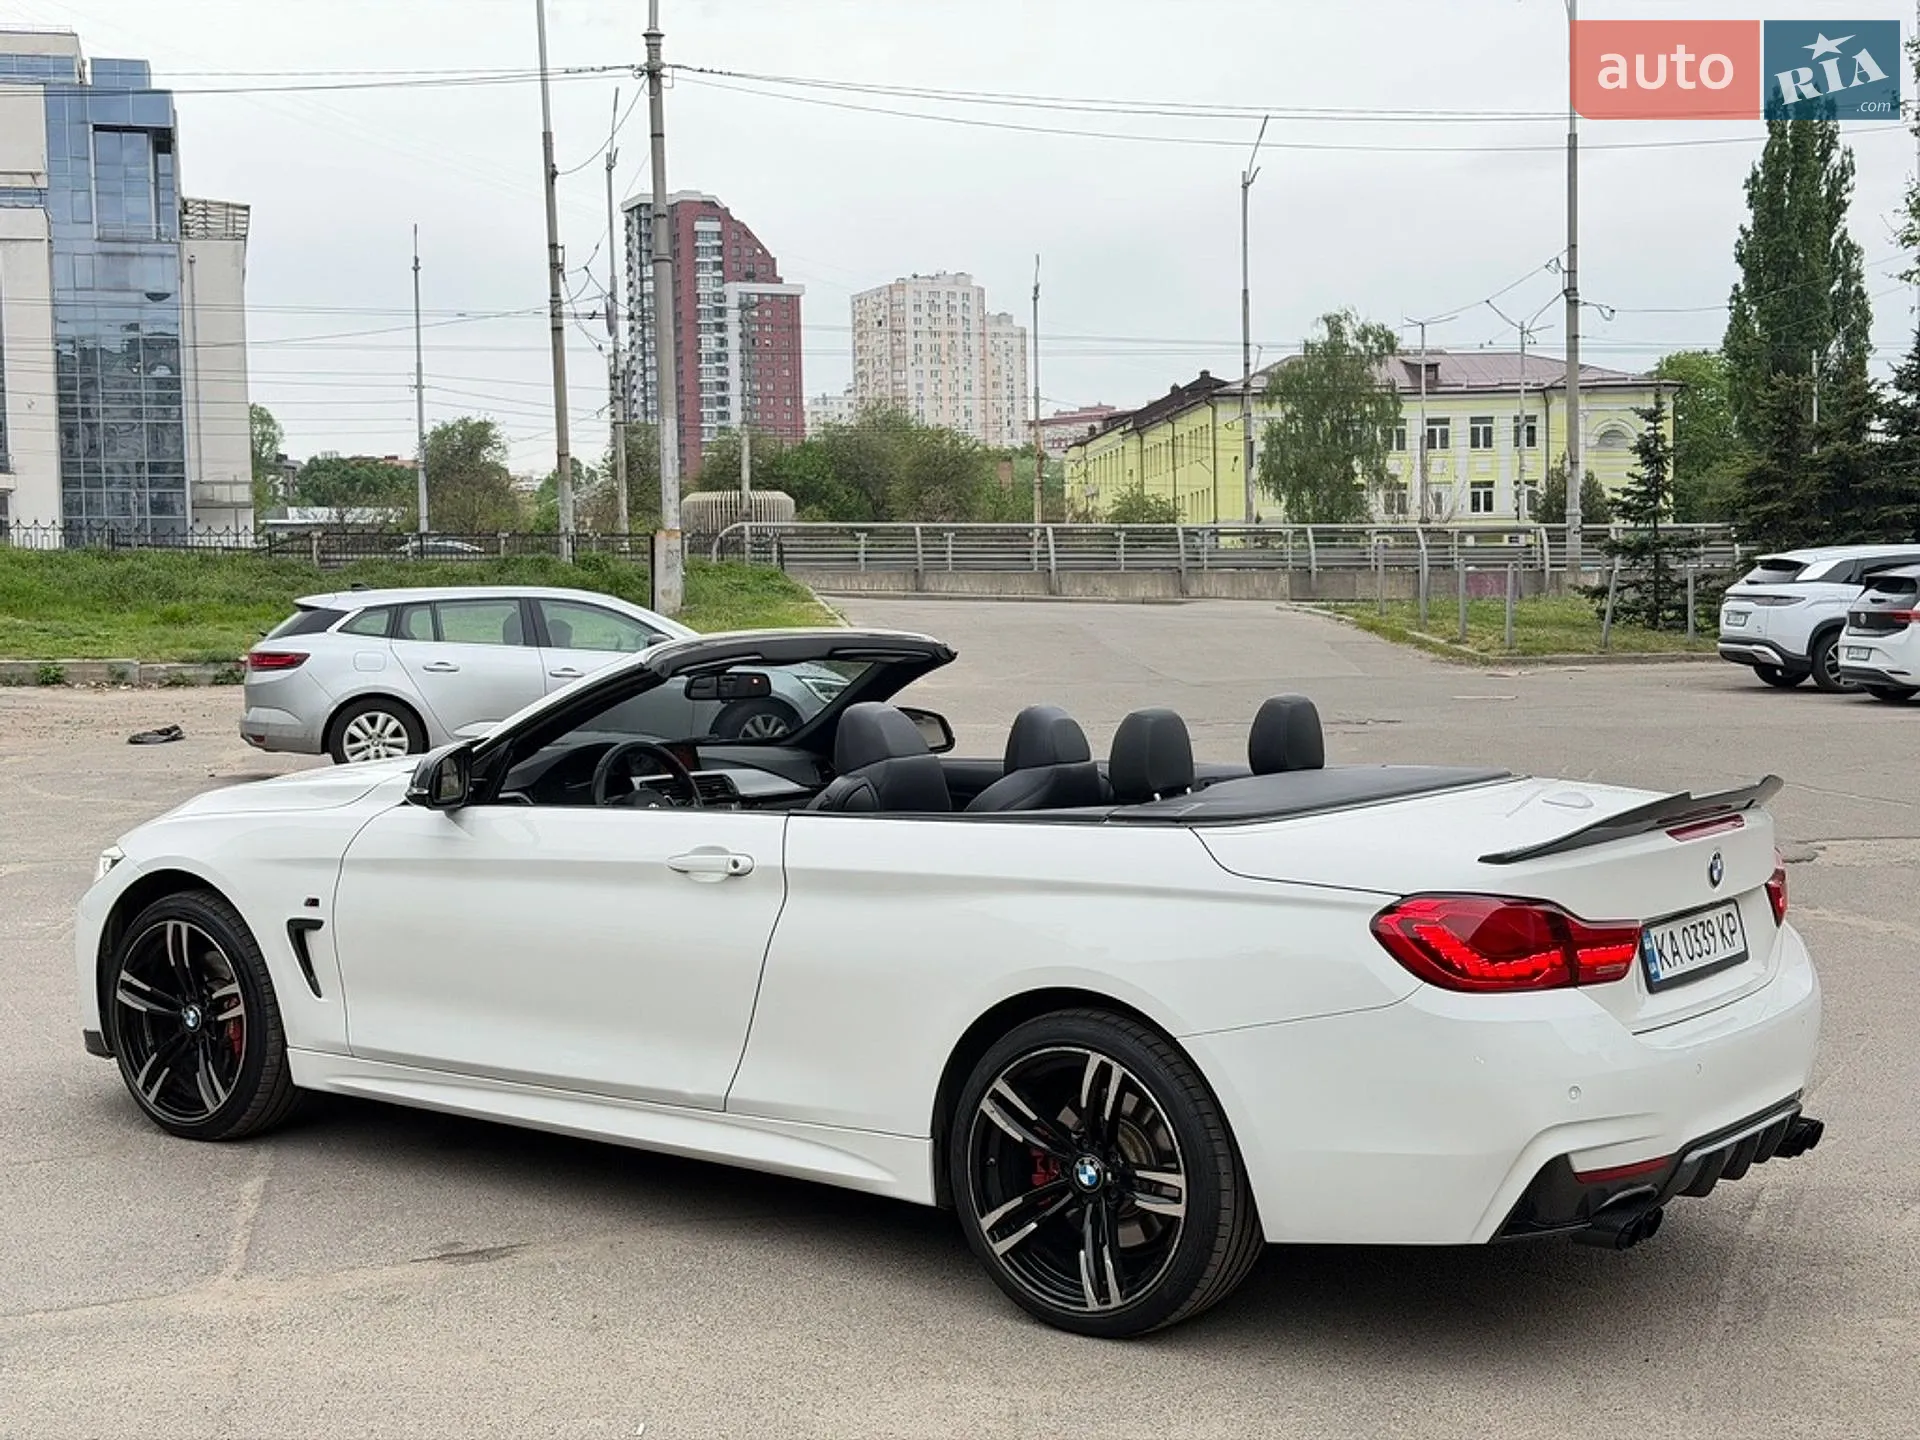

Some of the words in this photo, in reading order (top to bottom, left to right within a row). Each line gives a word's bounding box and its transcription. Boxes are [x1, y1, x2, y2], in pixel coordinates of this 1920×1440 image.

[1654, 930, 1685, 971] KA
[1682, 919, 1717, 961] 0339
[1716, 912, 1737, 950] KP
